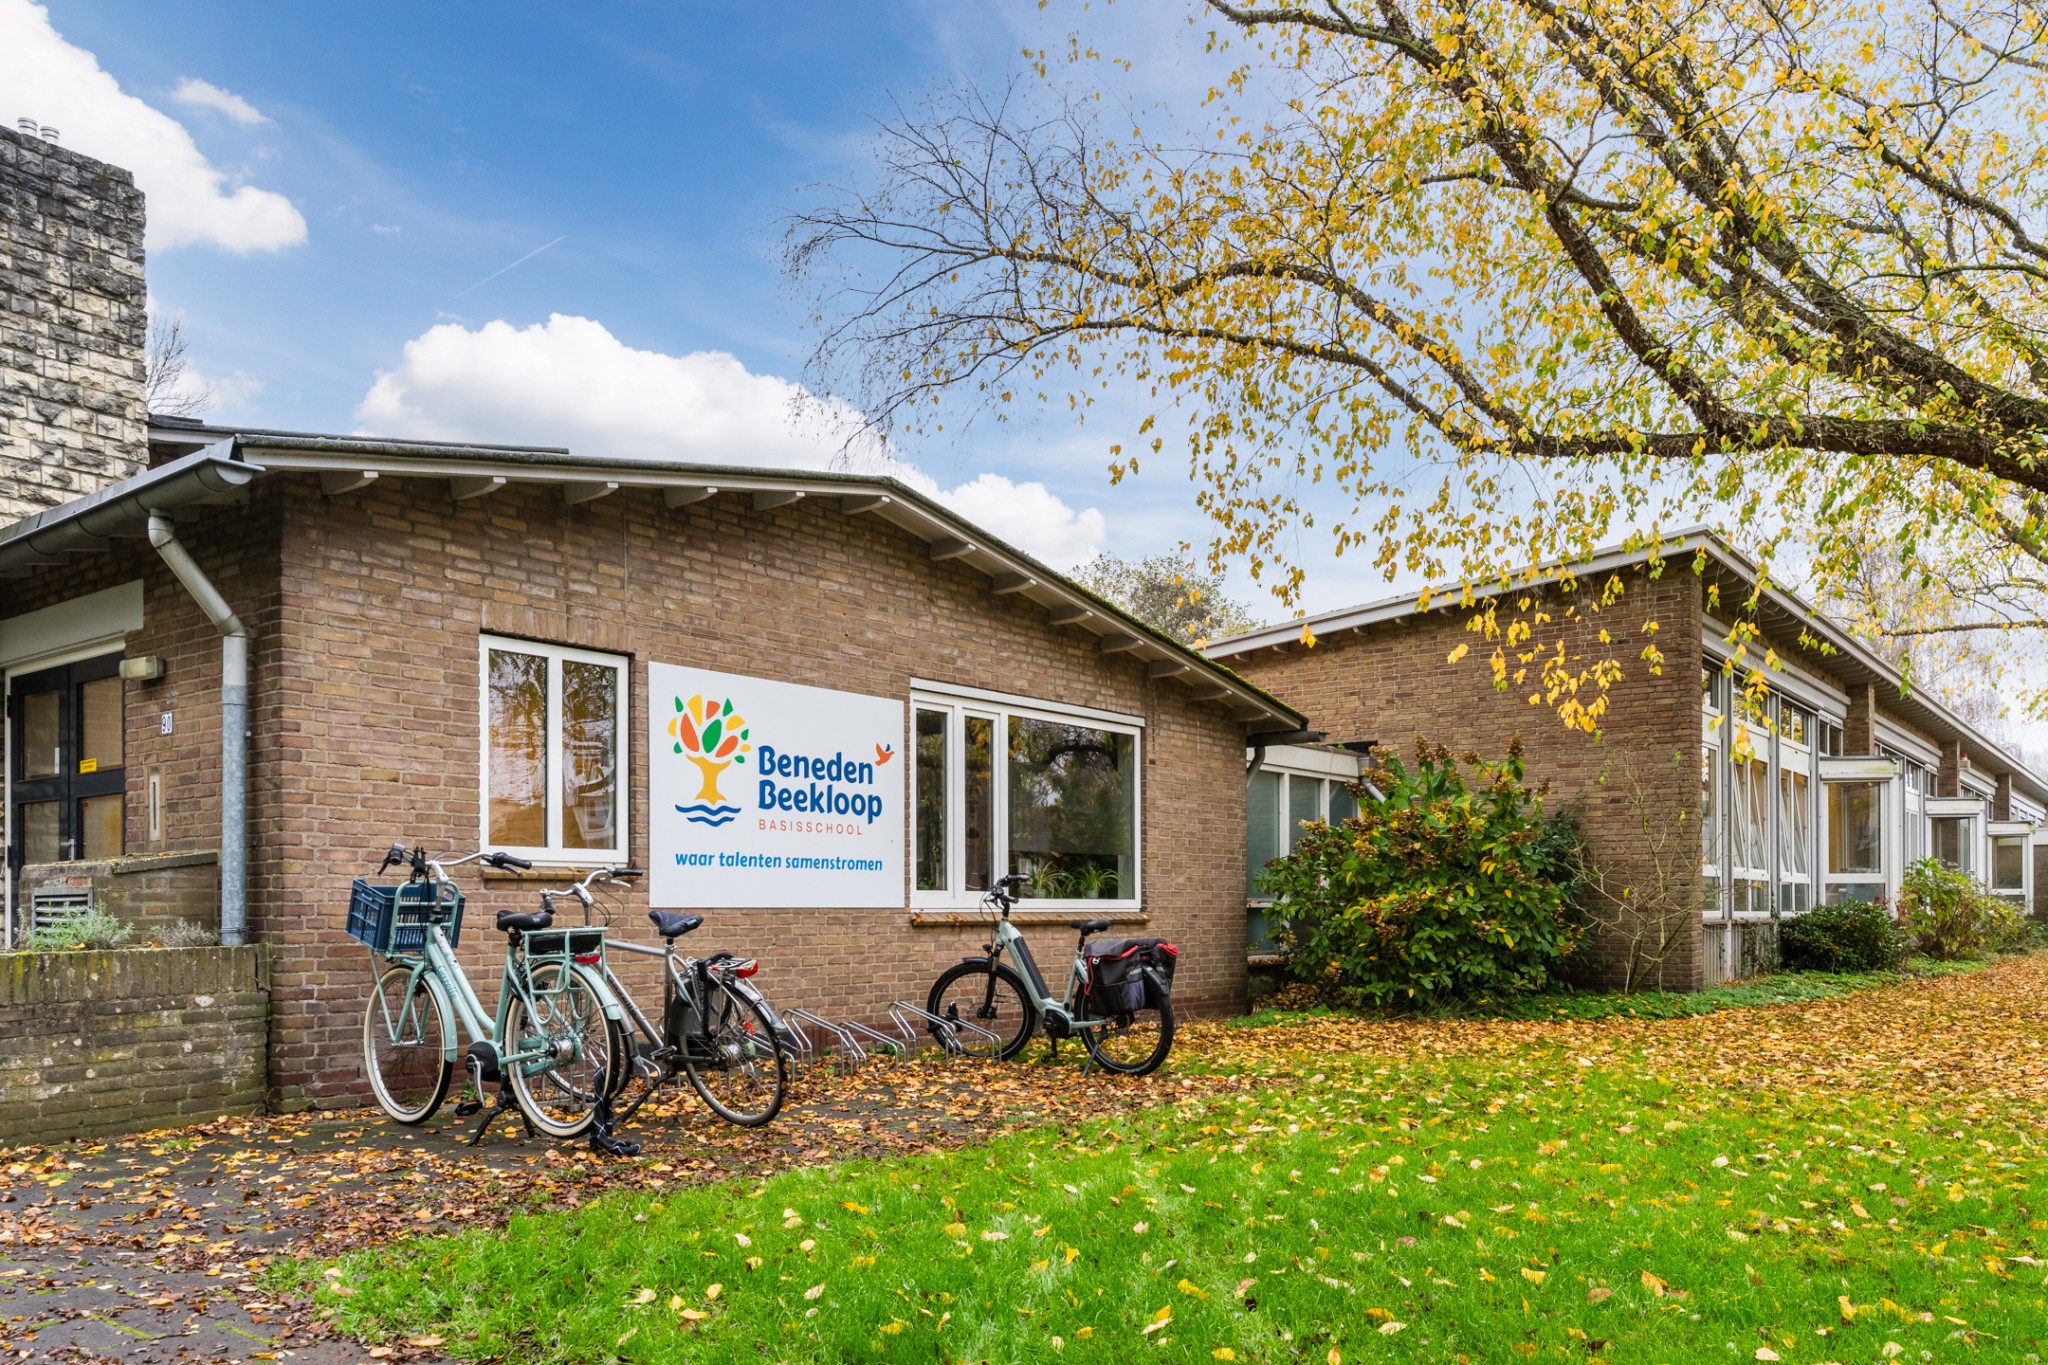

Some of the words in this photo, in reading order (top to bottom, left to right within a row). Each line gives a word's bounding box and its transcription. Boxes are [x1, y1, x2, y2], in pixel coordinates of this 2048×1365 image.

[162, 716, 171, 732] 90
[758, 745, 873, 784] Beneden
[758, 779, 883, 825] Beekloop
[758, 819, 862, 835] BASISSCHOOL
[675, 853, 715, 867] waar
[719, 851, 782, 869] talenten
[785, 856, 883, 871] samenstromen
